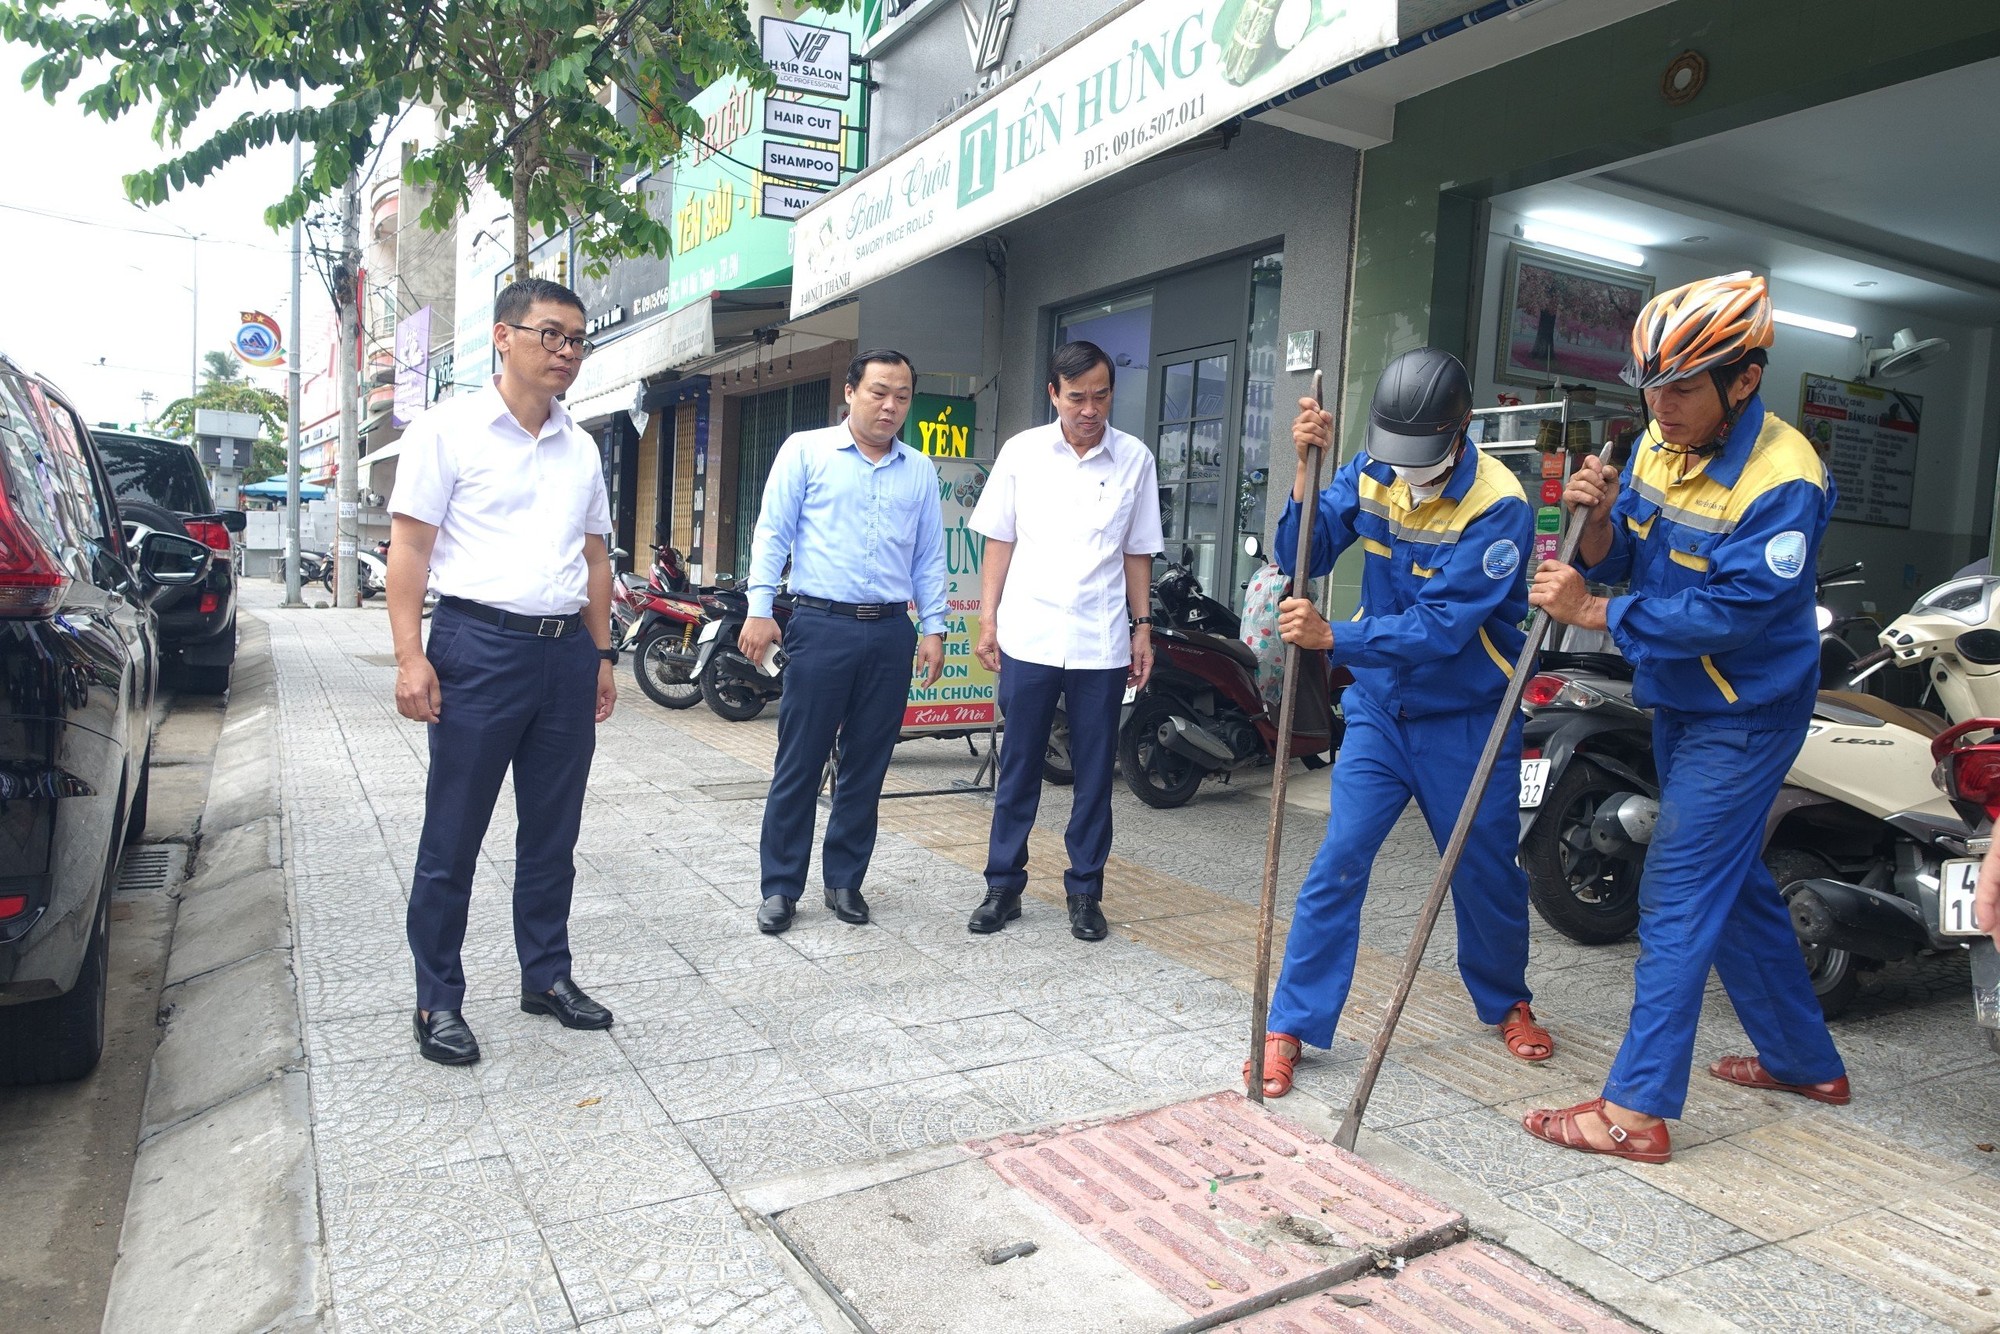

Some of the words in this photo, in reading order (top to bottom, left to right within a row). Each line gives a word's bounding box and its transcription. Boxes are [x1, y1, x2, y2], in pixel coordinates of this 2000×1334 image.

[769, 60, 799, 74] HAIR
[802, 66, 842, 81] SALON
[794, 76, 841, 91] PROFESSIONAL
[965, 80, 1065, 196] TIẾN
[1074, 10, 1207, 136] HƯNG
[774, 110, 804, 125] HAIR
[807, 116, 831, 130] CUT
[1084, 145, 1109, 171] ĐT:
[1112, 93, 1206, 157] 0916.507.011
[770, 153, 834, 172] SHAMPOO
[845, 176, 894, 241] Bánh
[677, 190, 703, 256] YẾN
[855, 234, 885, 261] SAVORY
[886, 226, 905, 248] RICE
[906, 209, 934, 235] ROLLS
[918, 406, 969, 458] YẾN
[949, 582, 958, 593] 2
[907, 684, 938, 701] ÁNH
[941, 683, 993, 700] CHƯNG
[915, 708, 949, 724] Kính
[954, 706, 986, 721] Mời
[1829, 737, 1895, 746] LEAD
